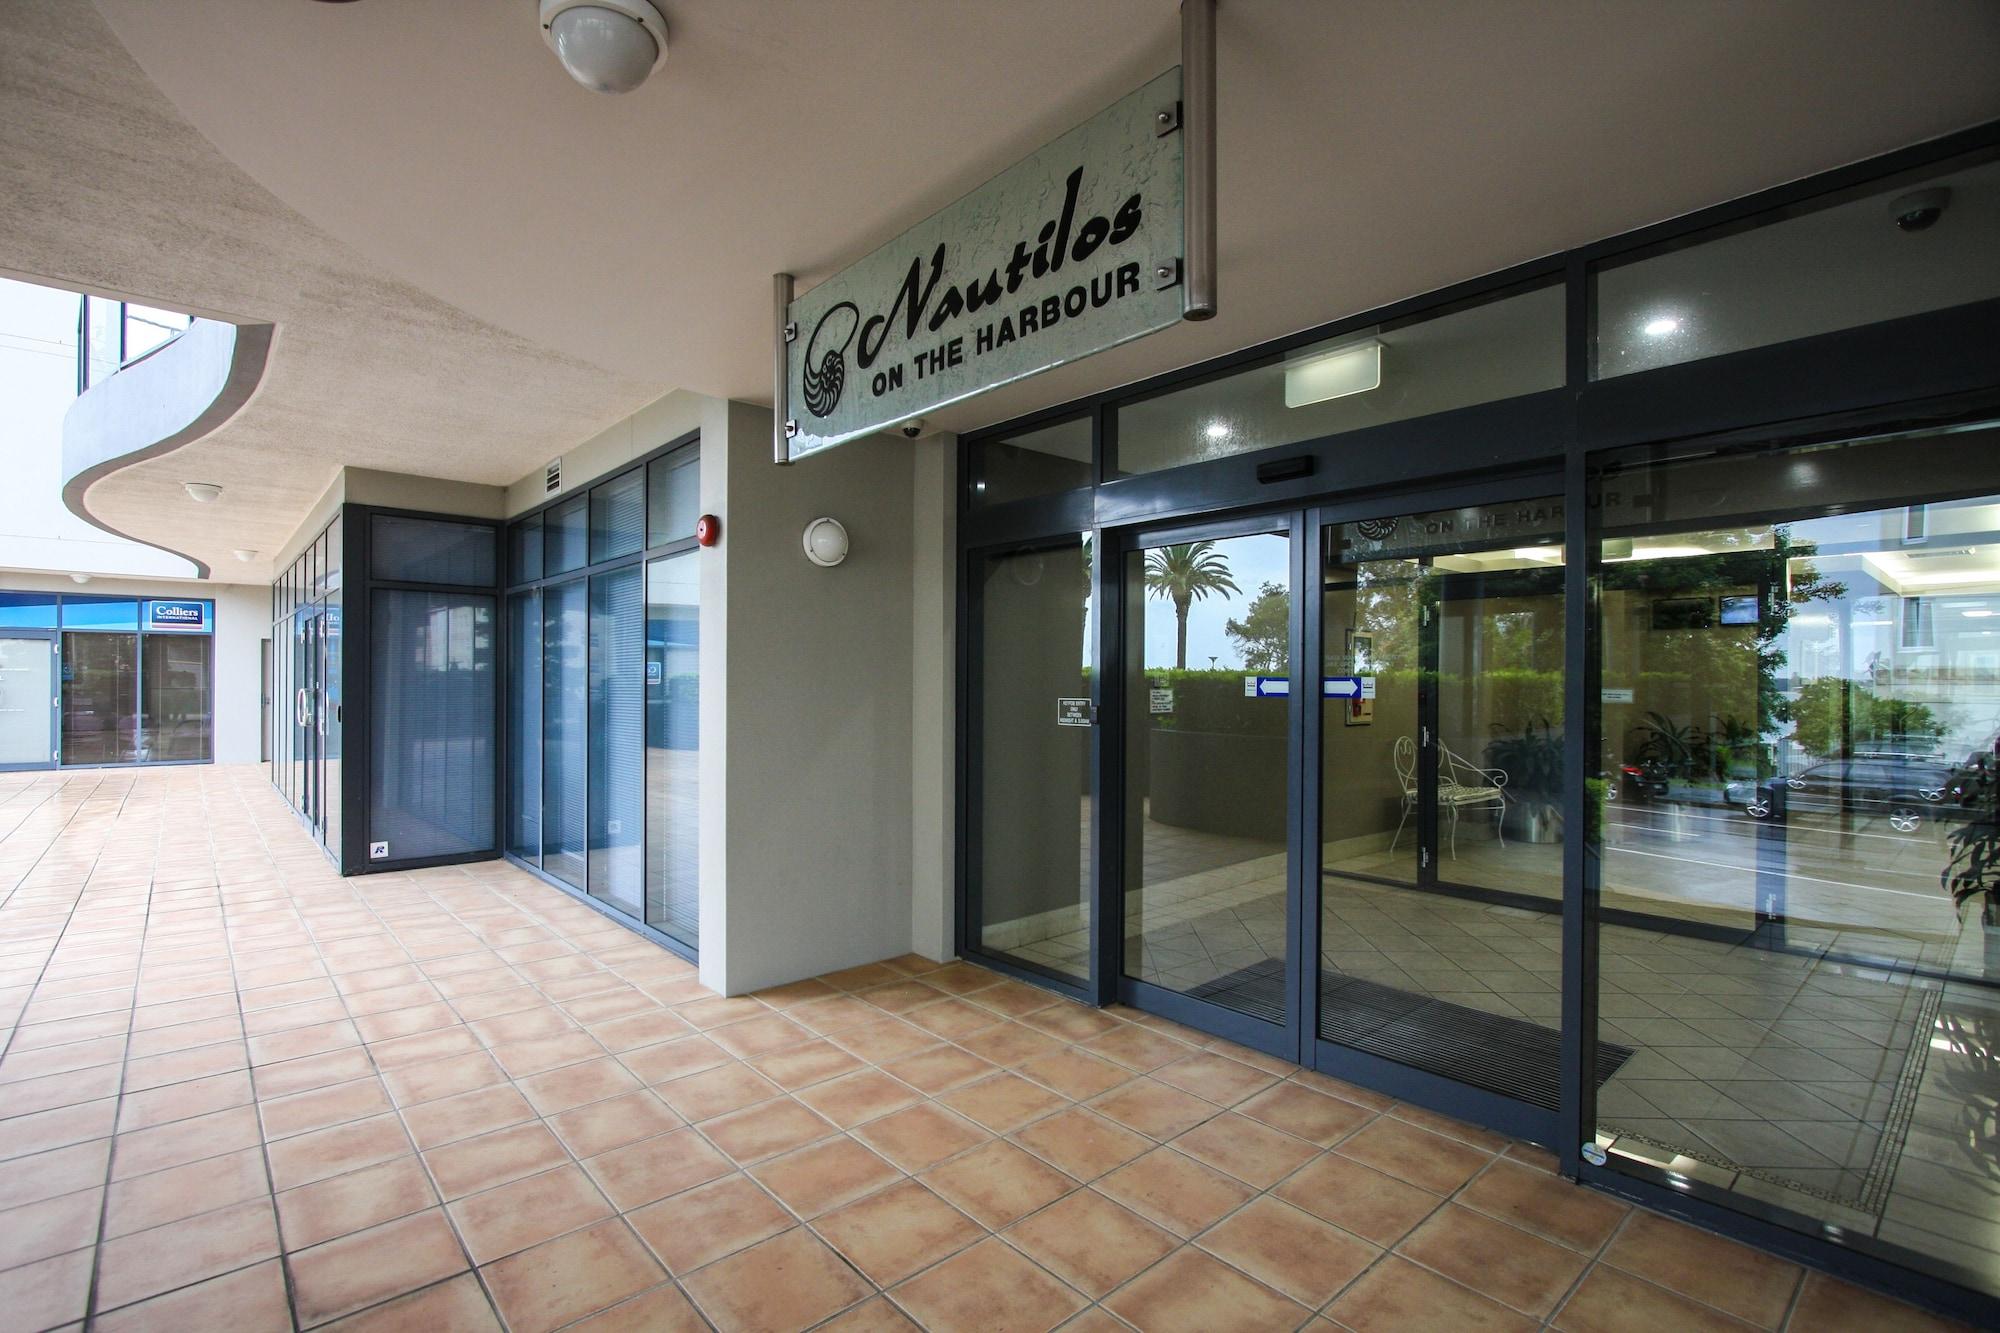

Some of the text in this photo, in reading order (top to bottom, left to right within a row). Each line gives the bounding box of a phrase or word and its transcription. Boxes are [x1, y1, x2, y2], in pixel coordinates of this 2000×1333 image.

[857, 165, 1141, 369] Nautilos
[872, 261, 1140, 397] ON THE HARBOUR
[156, 606, 198, 616] Colliers
